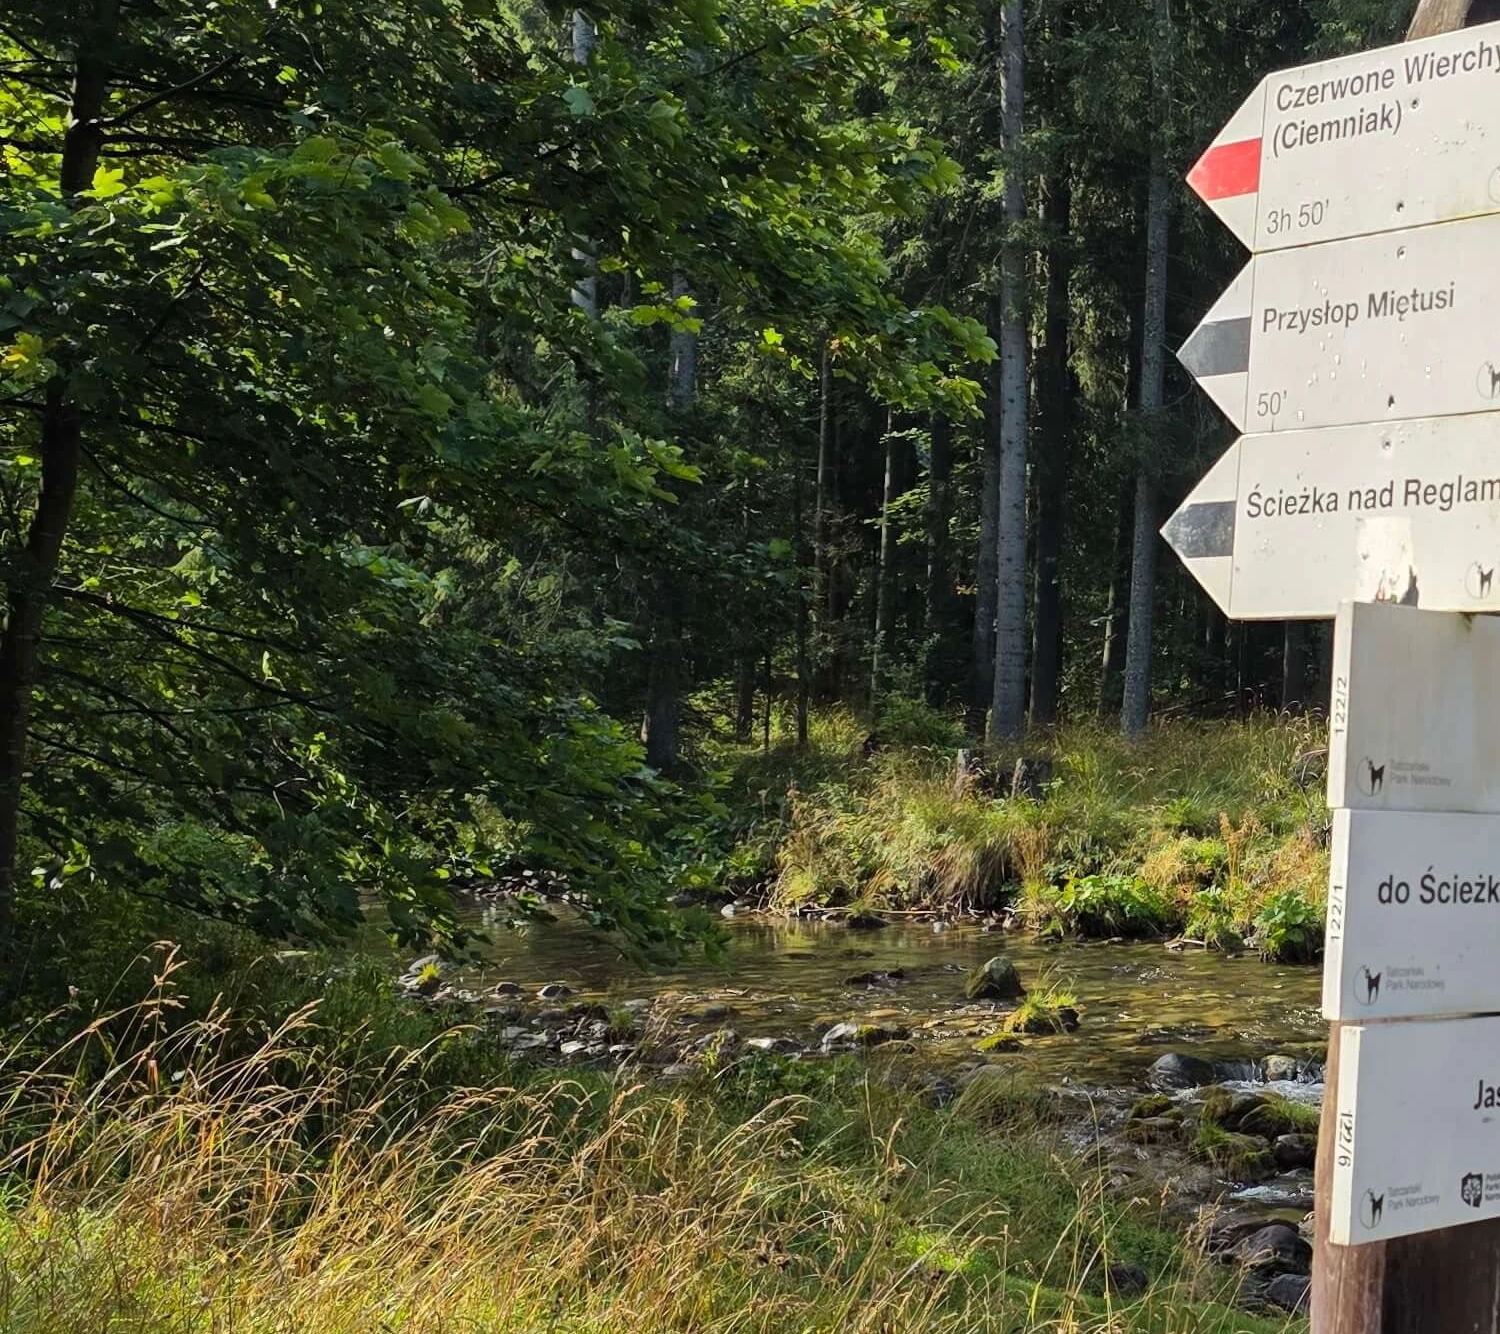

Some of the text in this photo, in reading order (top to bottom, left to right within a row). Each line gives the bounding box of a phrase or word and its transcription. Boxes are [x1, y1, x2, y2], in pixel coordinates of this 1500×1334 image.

[1277, 67, 1395, 112] Czerwone
[1273, 100, 1402, 157] (Ciemniak)
[1267, 199, 1330, 235] 3h 50'
[1262, 281, 1455, 334] Przysłop Miętusi
[1257, 389, 1288, 417] 50'
[1246, 484, 1339, 518] Ścieżka
[1347, 480, 1394, 511] nad
[1335, 676, 1348, 735] 122/2
[1330, 884, 1344, 941] 122/1
[1378, 873, 1410, 905] do
[1338, 1112, 1354, 1168] 122/6
